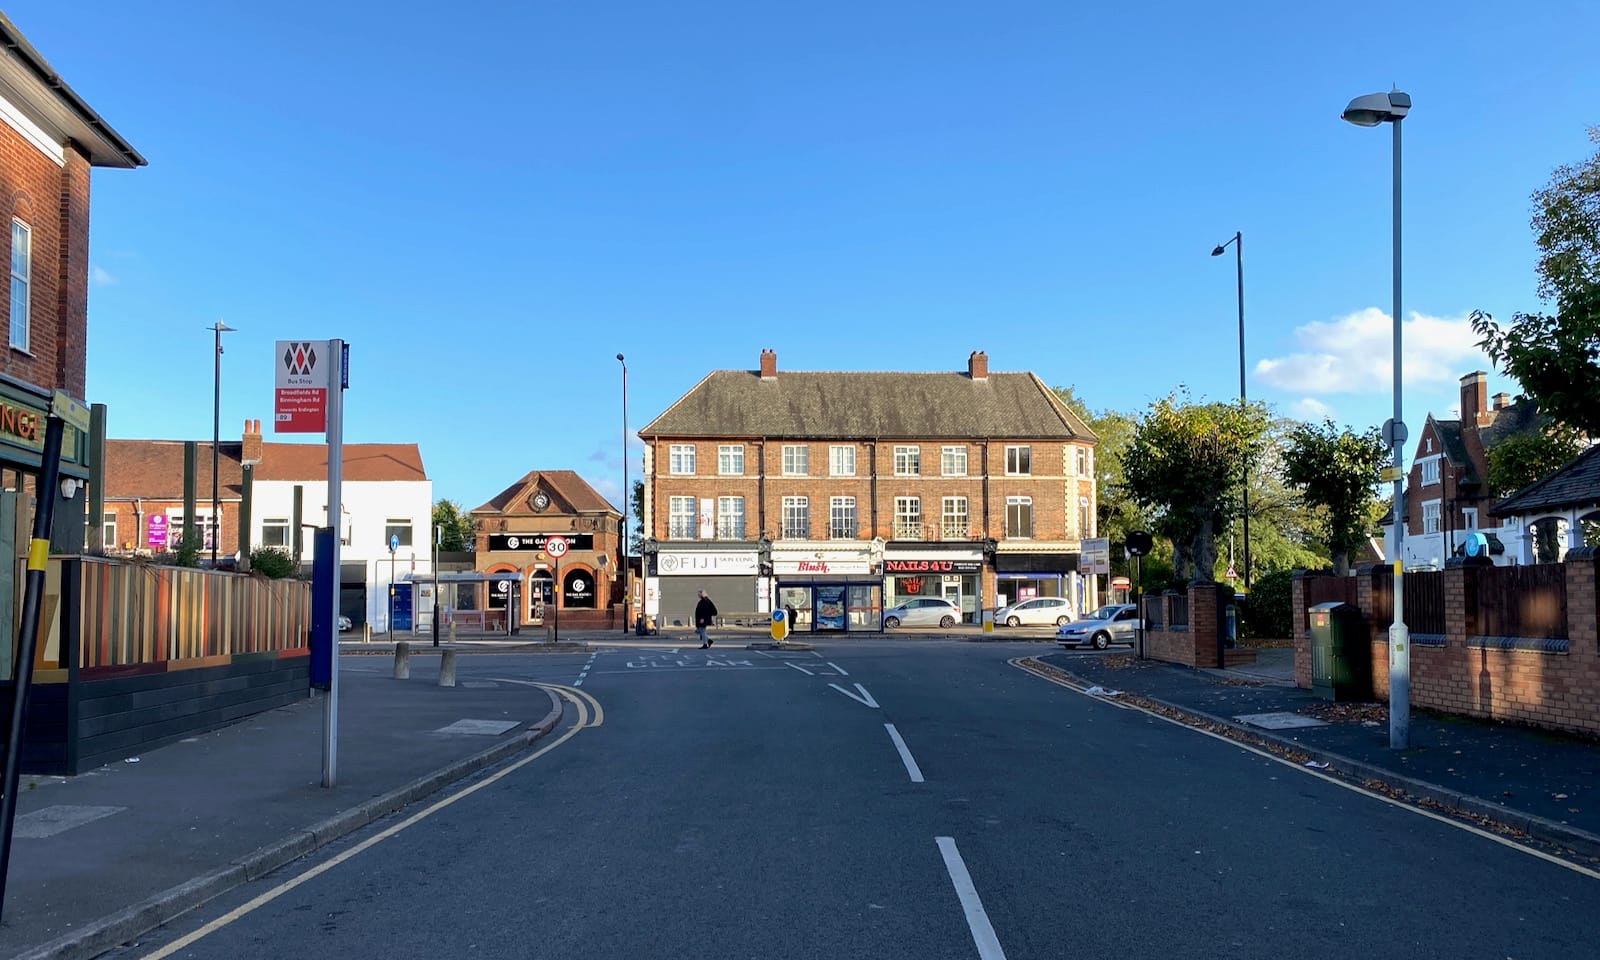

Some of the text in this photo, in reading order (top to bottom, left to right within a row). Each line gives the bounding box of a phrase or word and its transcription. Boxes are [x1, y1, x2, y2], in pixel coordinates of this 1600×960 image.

[549, 542, 565, 552] 30
[680, 557, 717, 568] FIJI
[886, 561, 929, 571] NAILS
